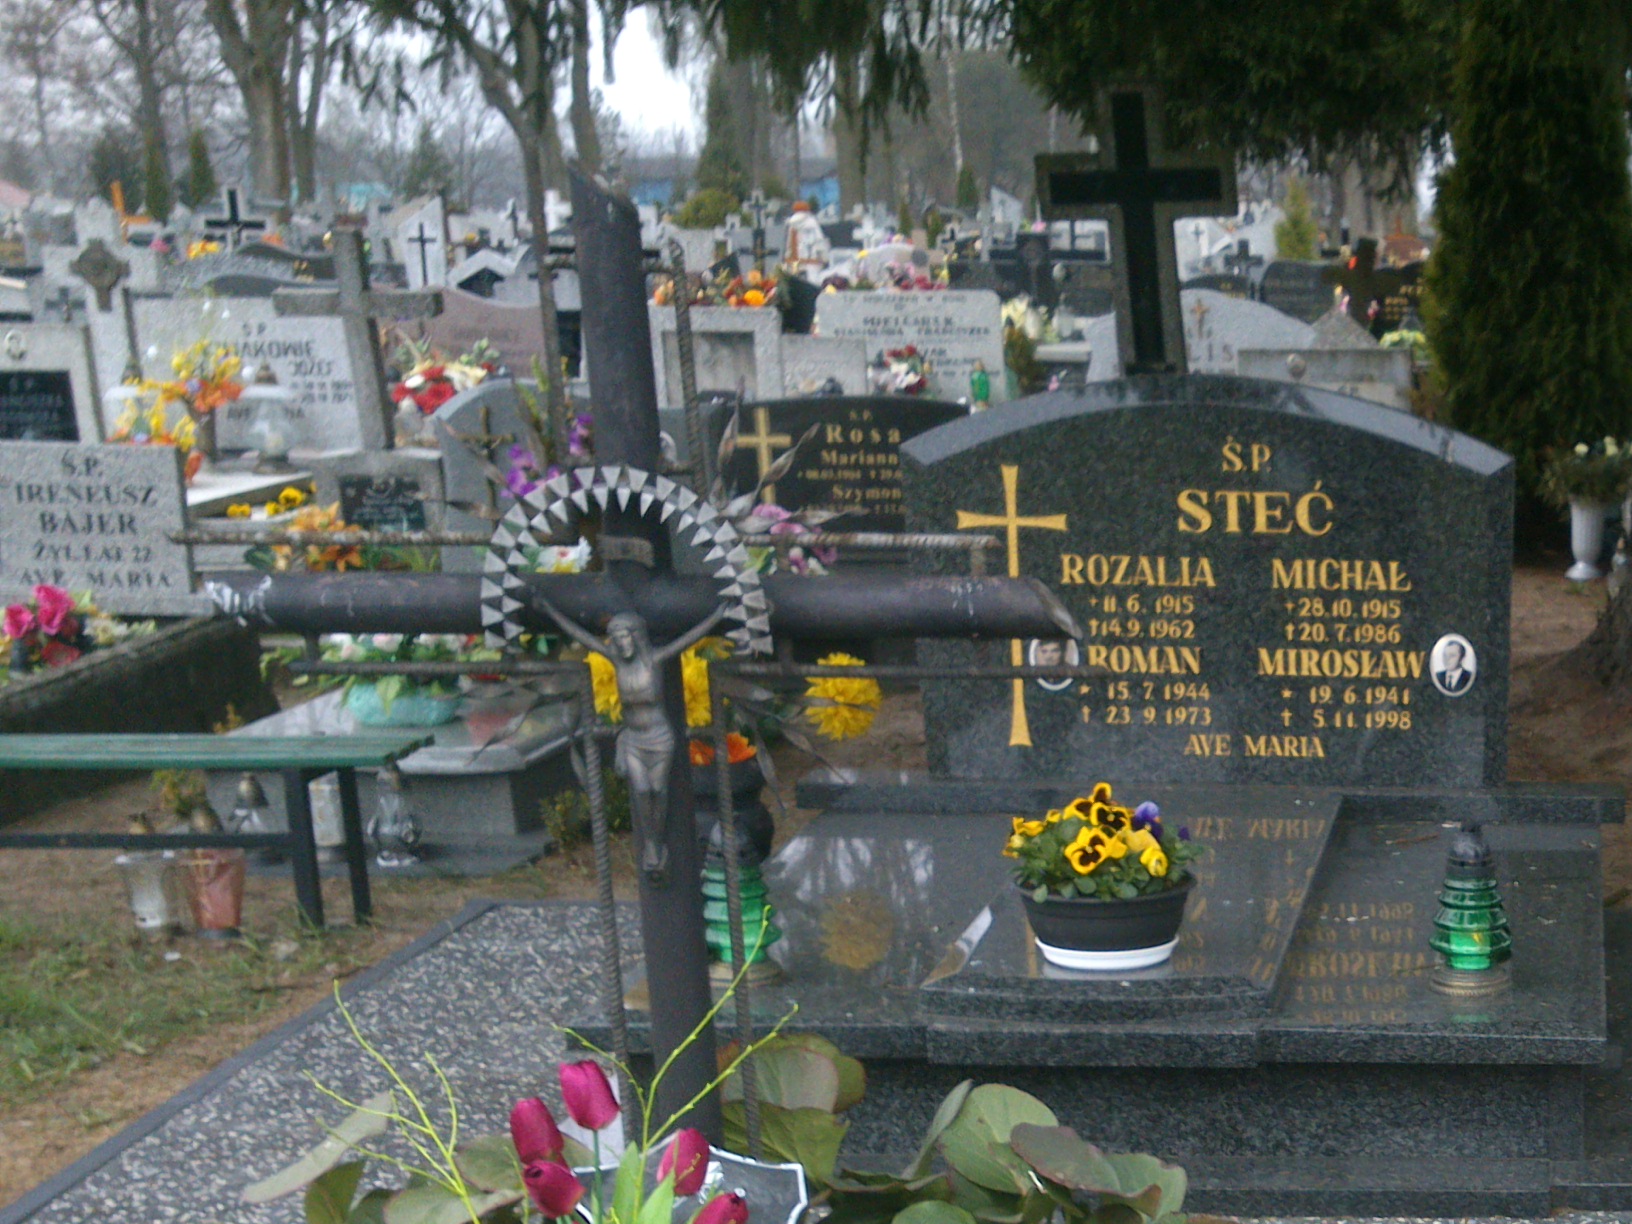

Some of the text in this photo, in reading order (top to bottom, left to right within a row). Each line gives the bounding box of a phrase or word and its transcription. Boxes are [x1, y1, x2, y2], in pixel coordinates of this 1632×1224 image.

[16, 483, 157, 507] IRENEUSZ
[1176, 479, 1335, 536] STEĆ
[39, 511, 138, 535] BAJER
[1060, 553, 1217, 588] ROZALIA
[1272, 557, 1412, 592] MICHAŁ
[1088, 645, 1202, 675] ROMAN
[1257, 647, 1427, 679] MIROSŁAW
[1183, 733, 1326, 758] AVE MARIA
